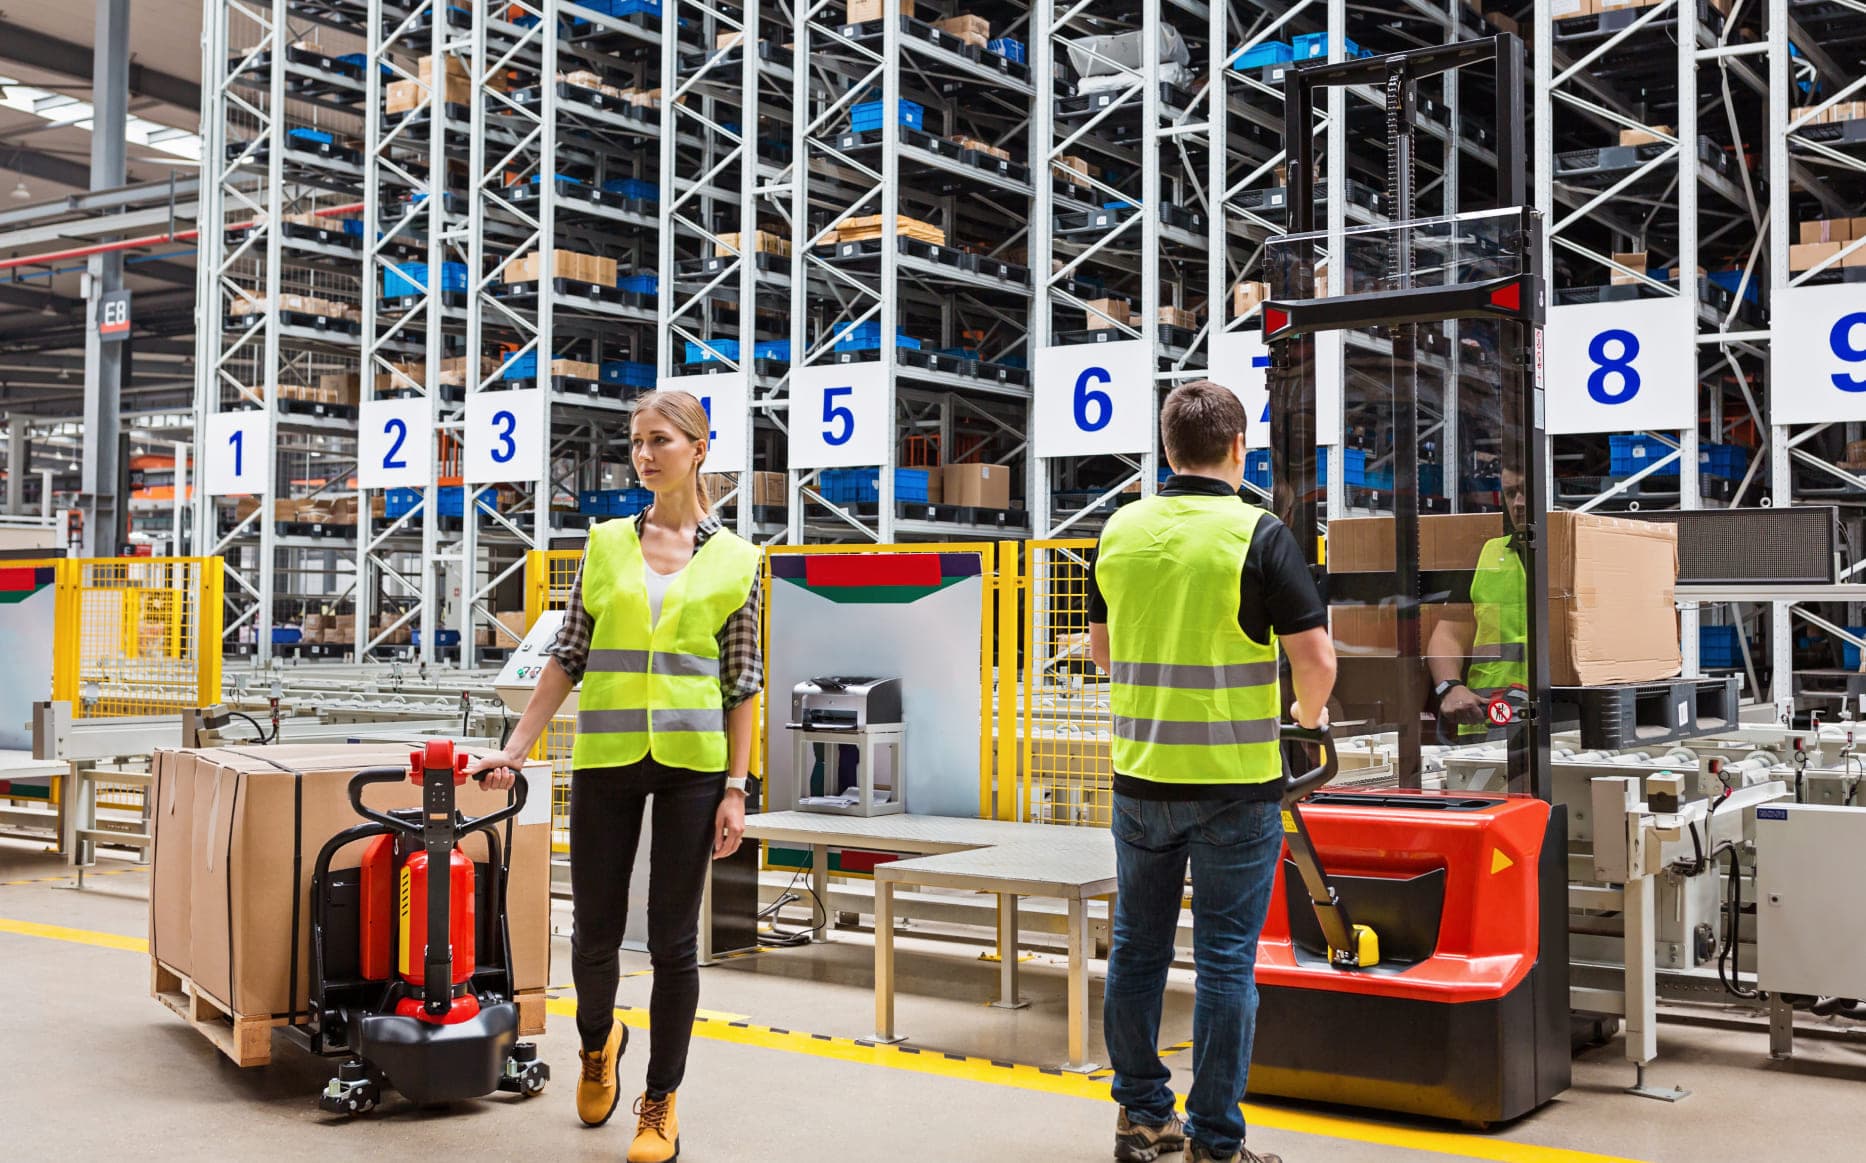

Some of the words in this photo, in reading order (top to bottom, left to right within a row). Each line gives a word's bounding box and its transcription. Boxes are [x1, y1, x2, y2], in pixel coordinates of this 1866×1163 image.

[105, 300, 126, 326] E8
[1587, 328, 1641, 405] 8
[822, 386, 855, 446] 5
[1073, 366, 1113, 432] 6
[228, 430, 243, 477] 1
[382, 418, 408, 469] 2
[490, 410, 517, 463] 3
